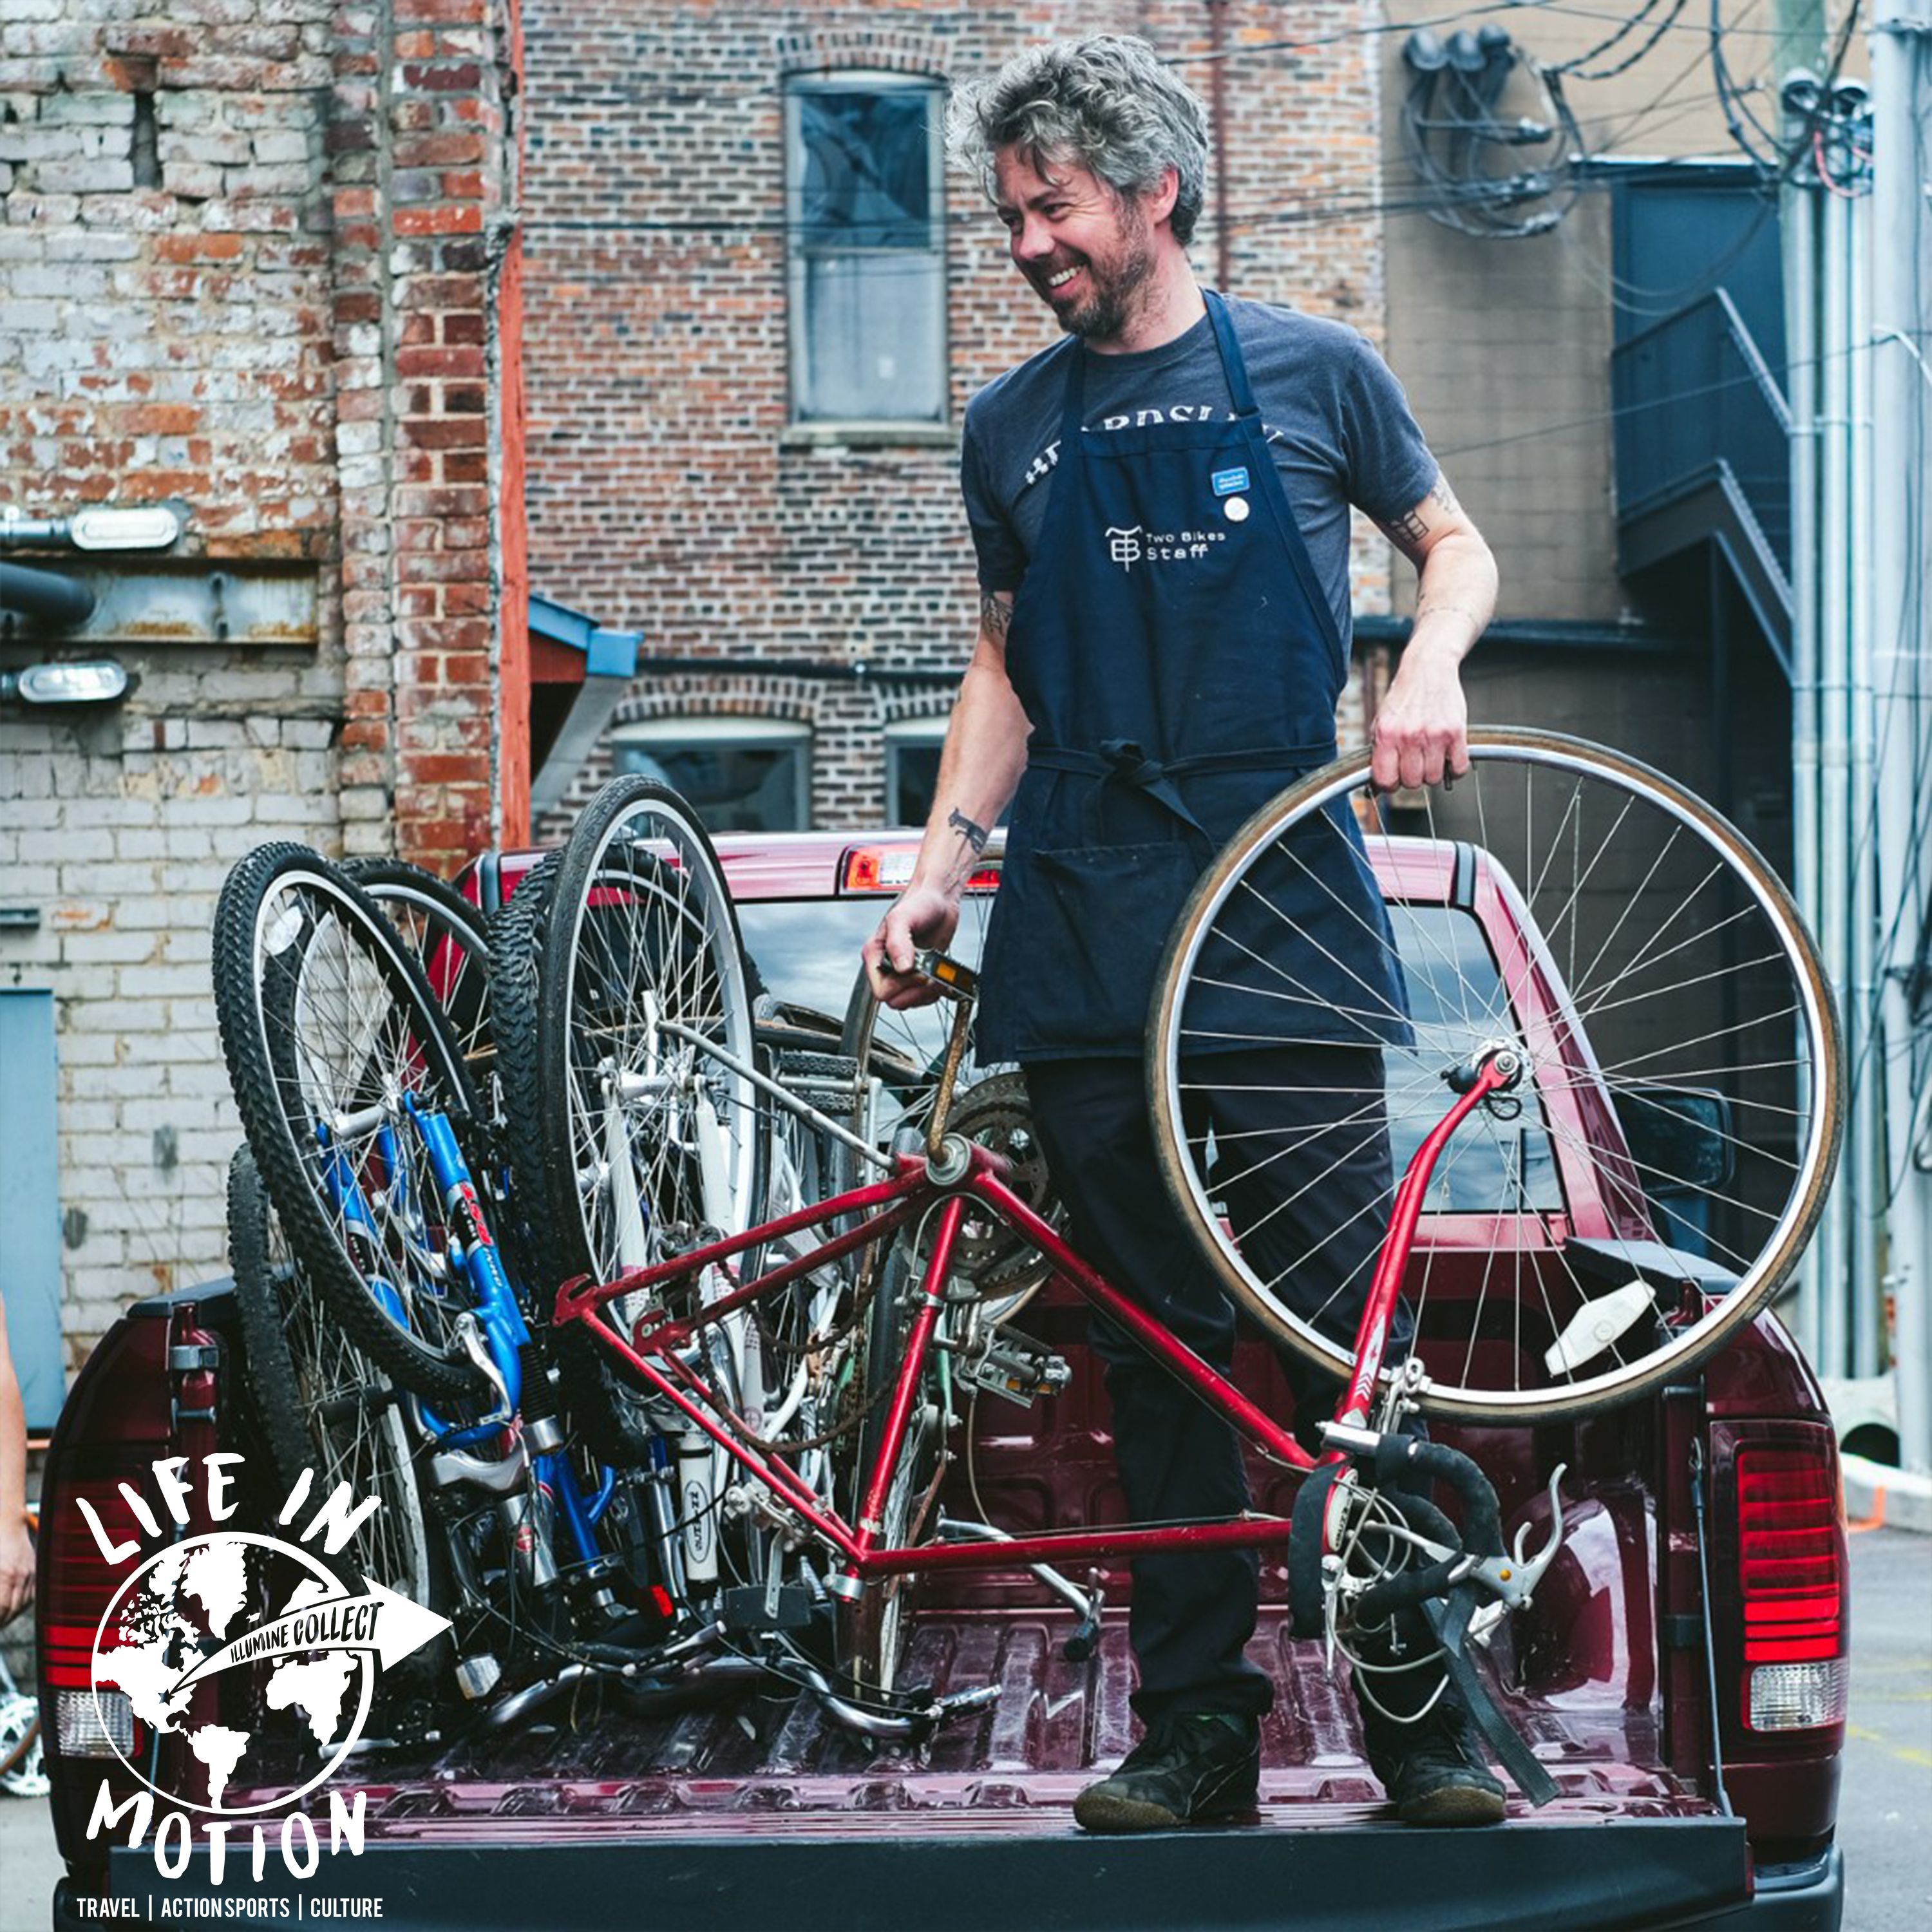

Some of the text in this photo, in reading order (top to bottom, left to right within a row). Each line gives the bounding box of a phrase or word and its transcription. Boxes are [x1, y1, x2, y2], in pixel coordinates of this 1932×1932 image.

[1146, 531, 1226, 543] Two Bikes
[1146, 544, 1209, 561] Staff
